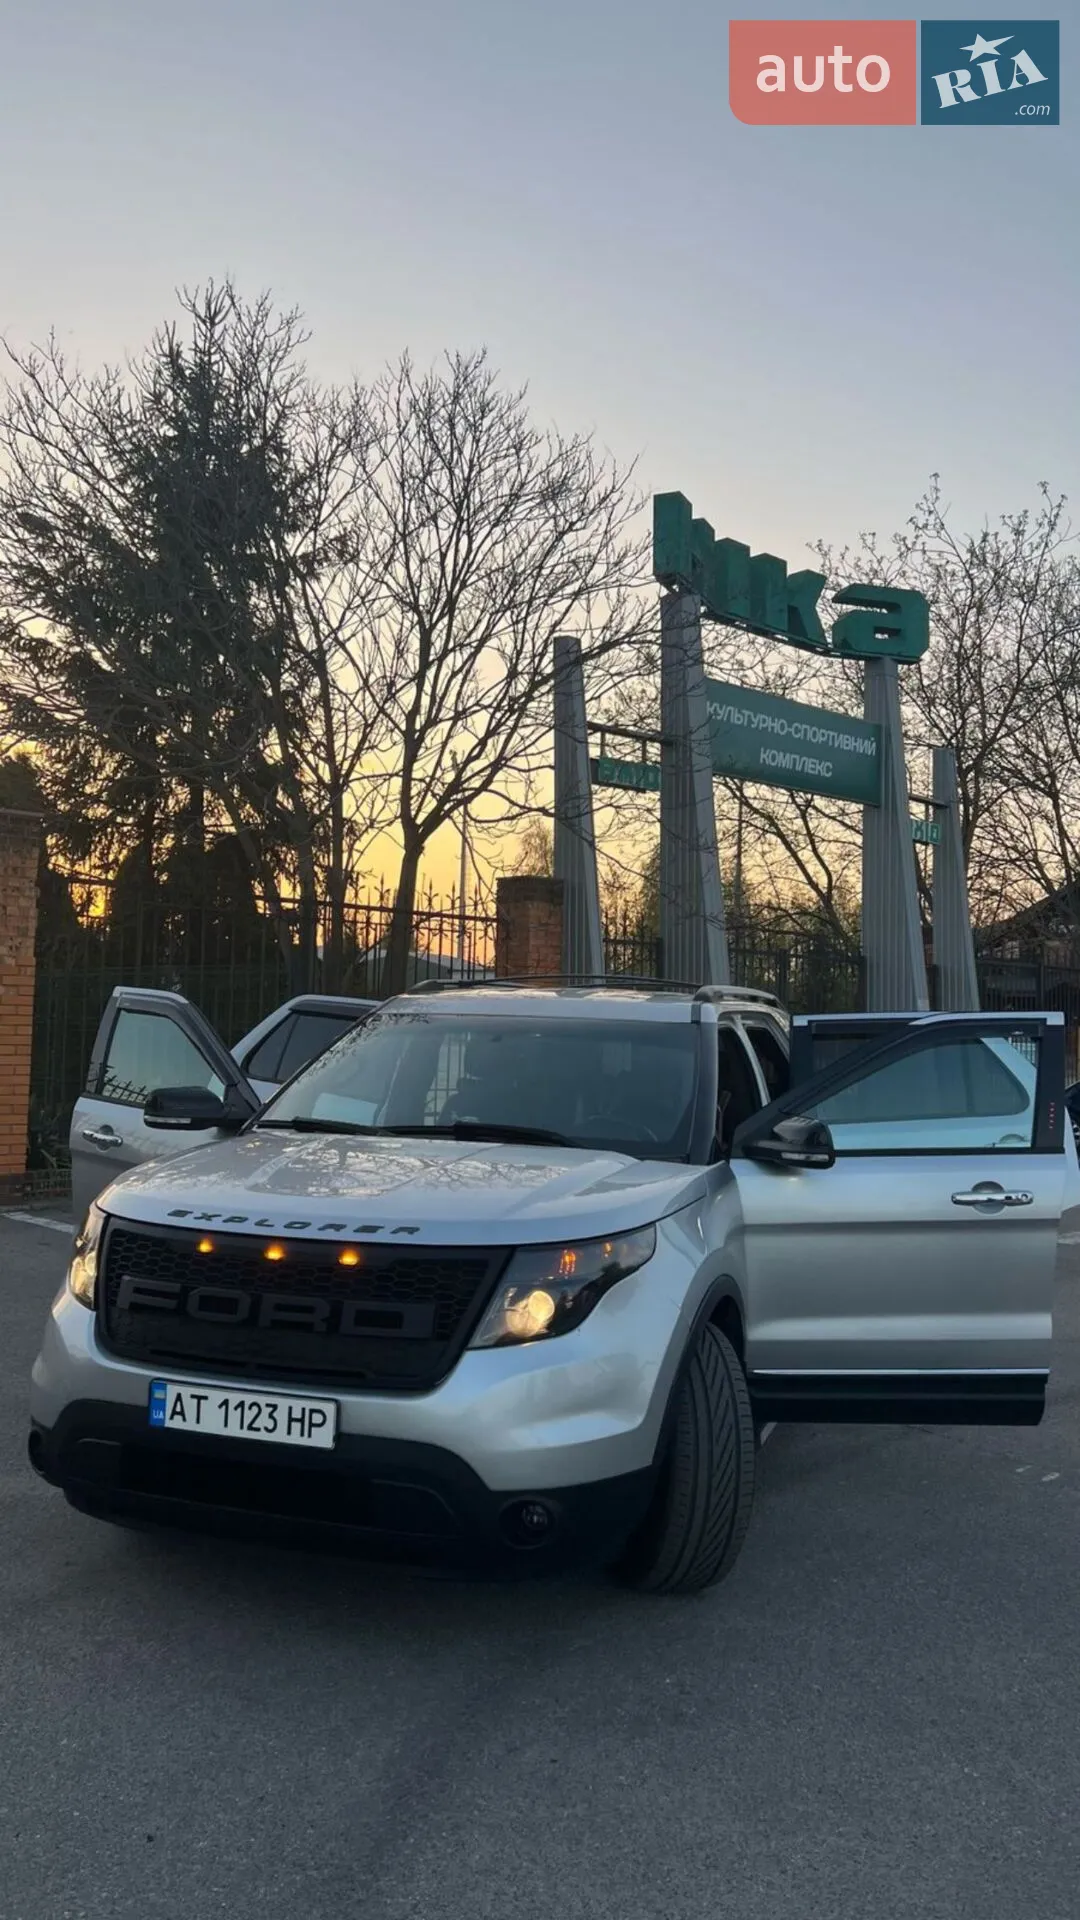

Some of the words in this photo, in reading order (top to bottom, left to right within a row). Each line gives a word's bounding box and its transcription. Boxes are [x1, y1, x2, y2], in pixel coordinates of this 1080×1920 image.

[706, 701, 877, 757] КУЛЬТУРНО-СПОРТИВНИЙ
[760, 747, 833, 777] КОМПЛЕКС
[167, 1208, 421, 1236] EXPLORER
[116, 1275, 437, 1339] FORD
[152, 1409, 165, 1420] UA
[217, 1398, 278, 1434] 1123
